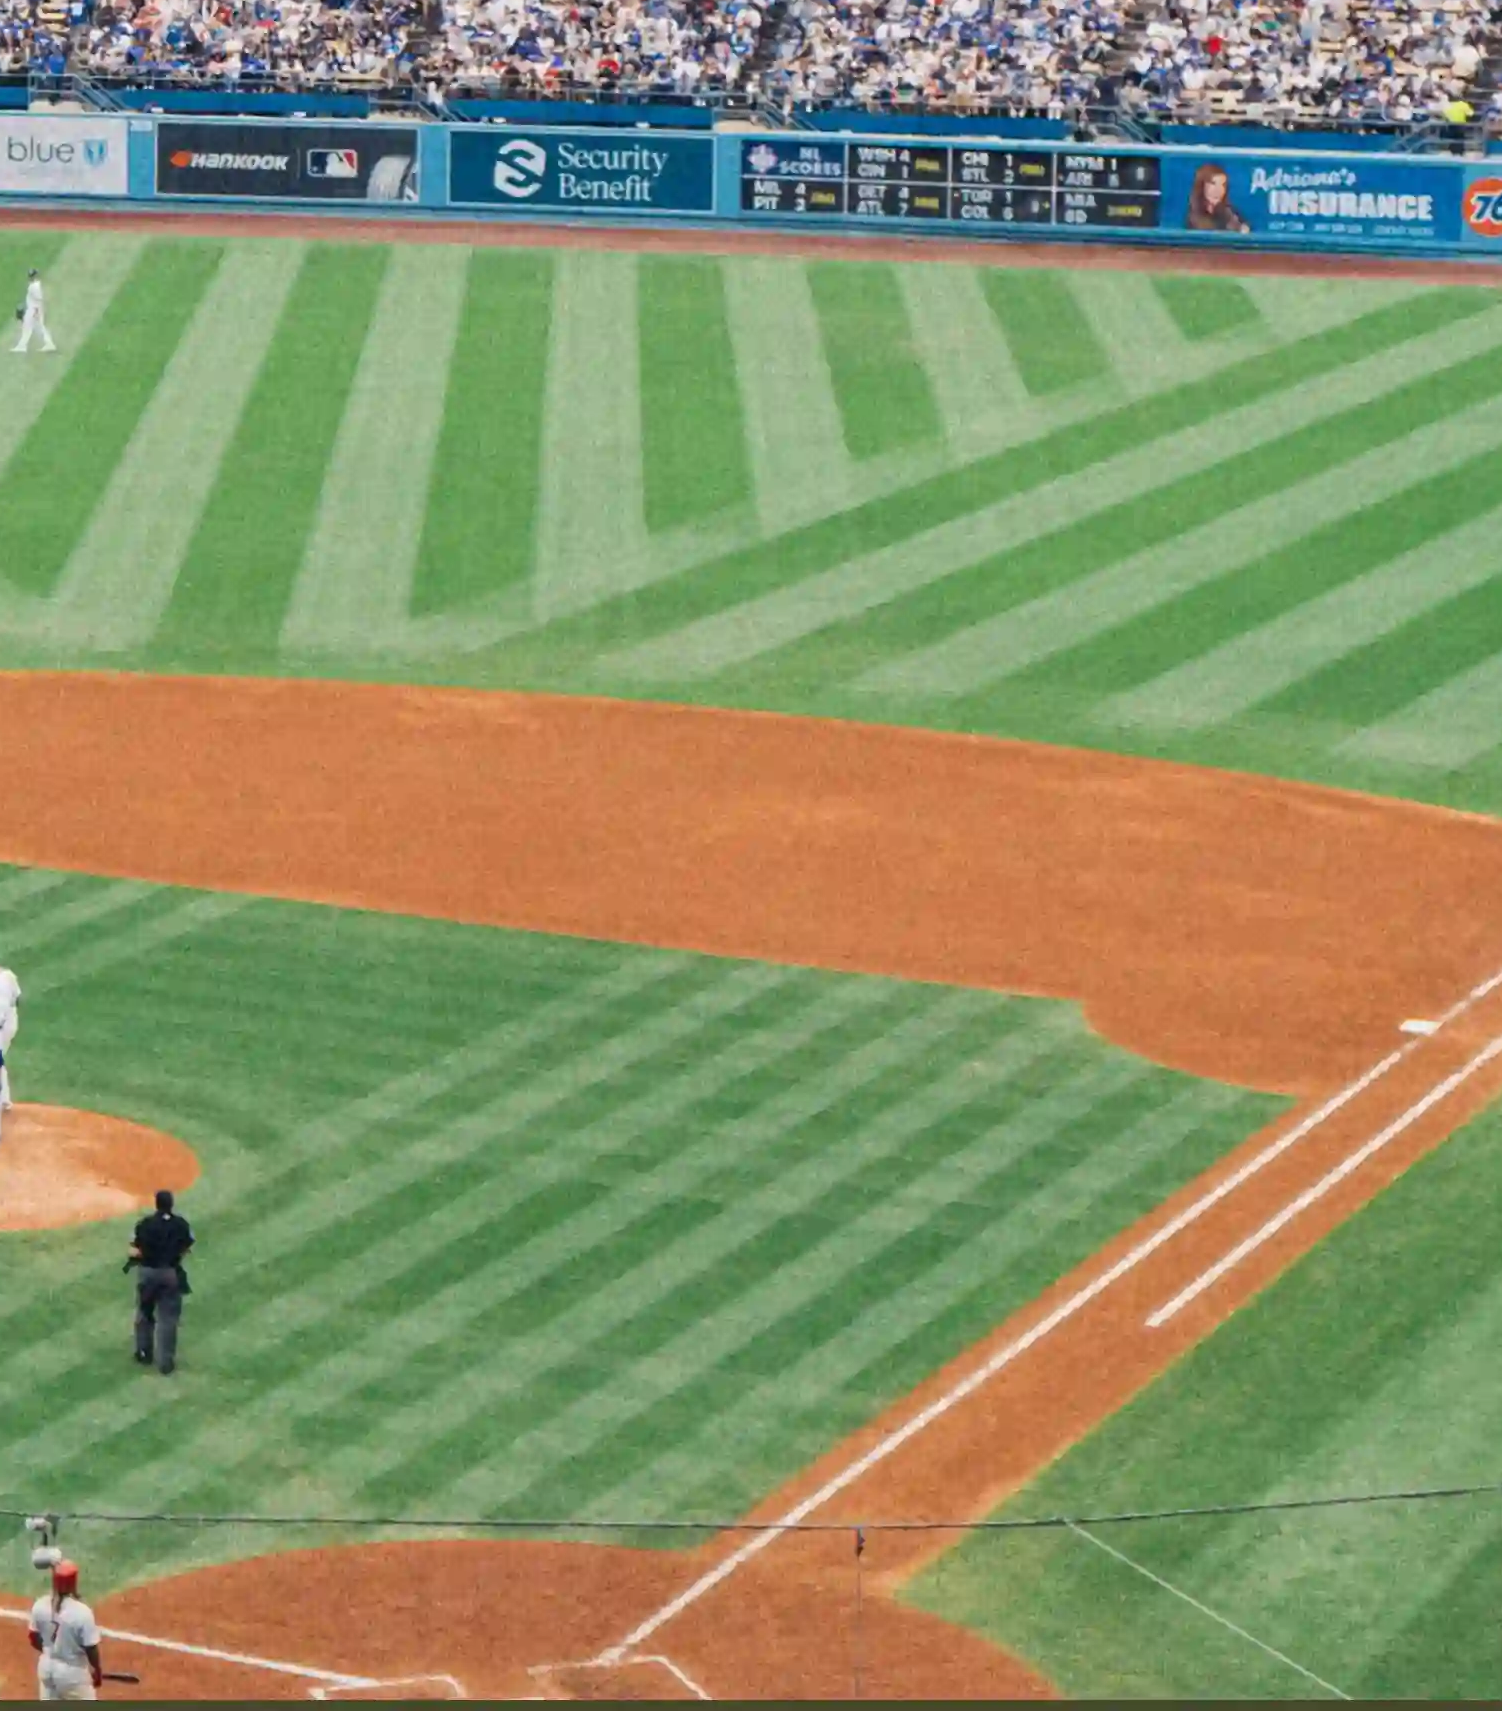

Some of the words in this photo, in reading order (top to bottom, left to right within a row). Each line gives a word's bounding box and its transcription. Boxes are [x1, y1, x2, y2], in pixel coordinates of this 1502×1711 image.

[7, 136, 75, 163] blue
[558, 141, 668, 177] Security
[779, 161, 841, 176] SCORES
[1251, 166, 1356, 194] Adriana's
[558, 173, 652, 202] Benefit
[1269, 189, 1433, 221] INSURANCE
